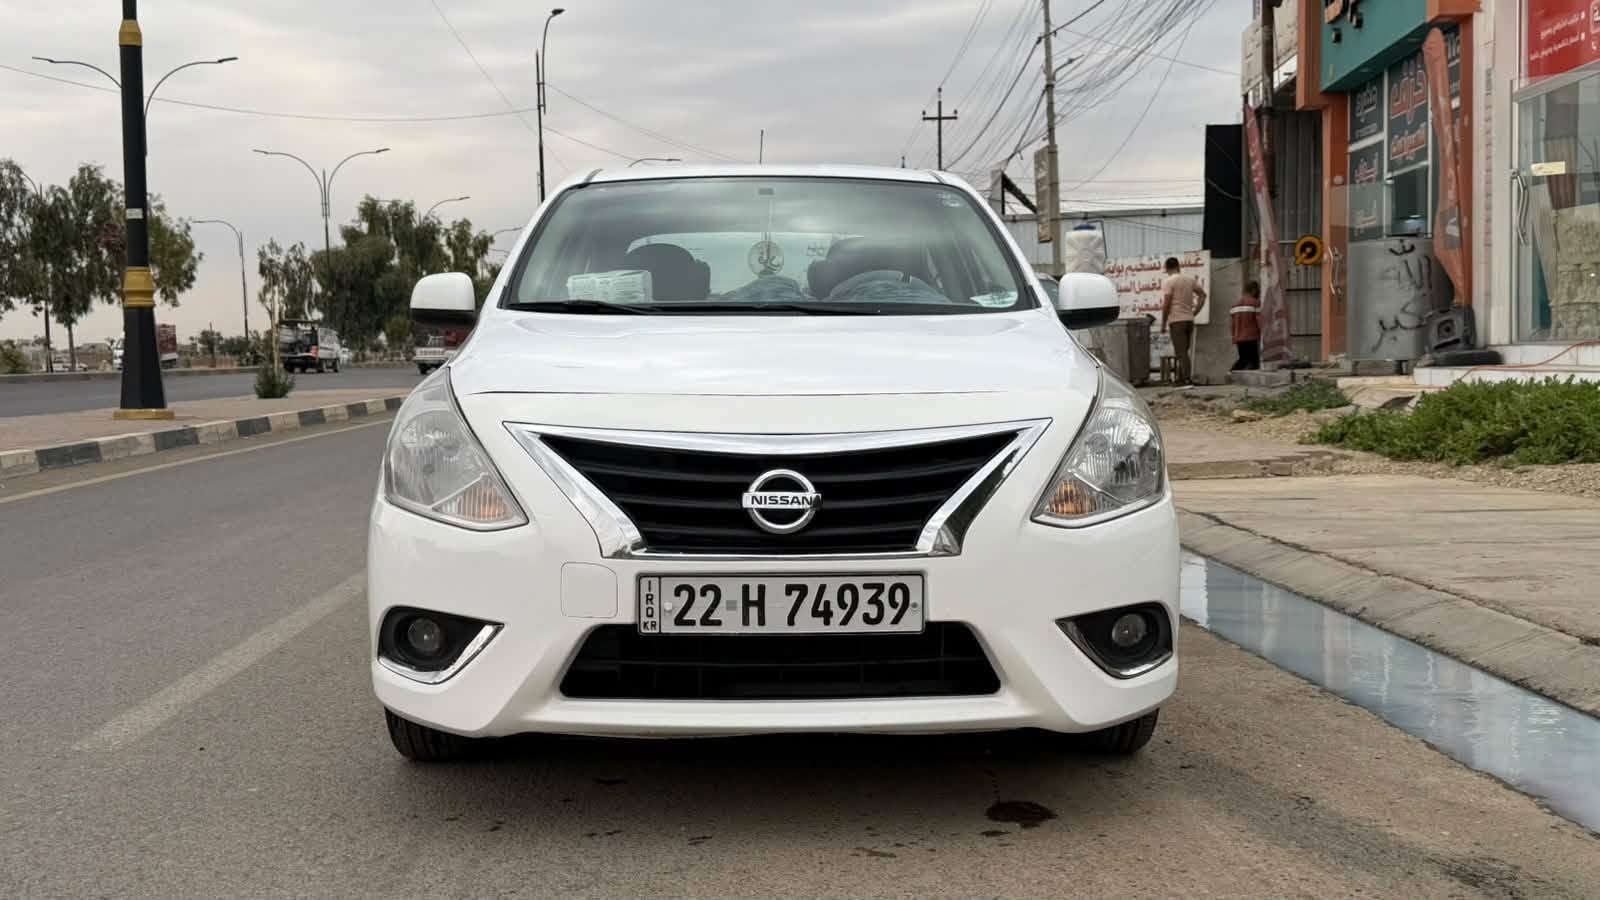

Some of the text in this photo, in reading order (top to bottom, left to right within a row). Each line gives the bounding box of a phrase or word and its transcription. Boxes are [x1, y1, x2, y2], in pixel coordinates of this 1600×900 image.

[751, 494, 813, 506] NISSAN
[673, 582, 911, 627] 22 H 74939
[643, 620, 657, 631] KR
